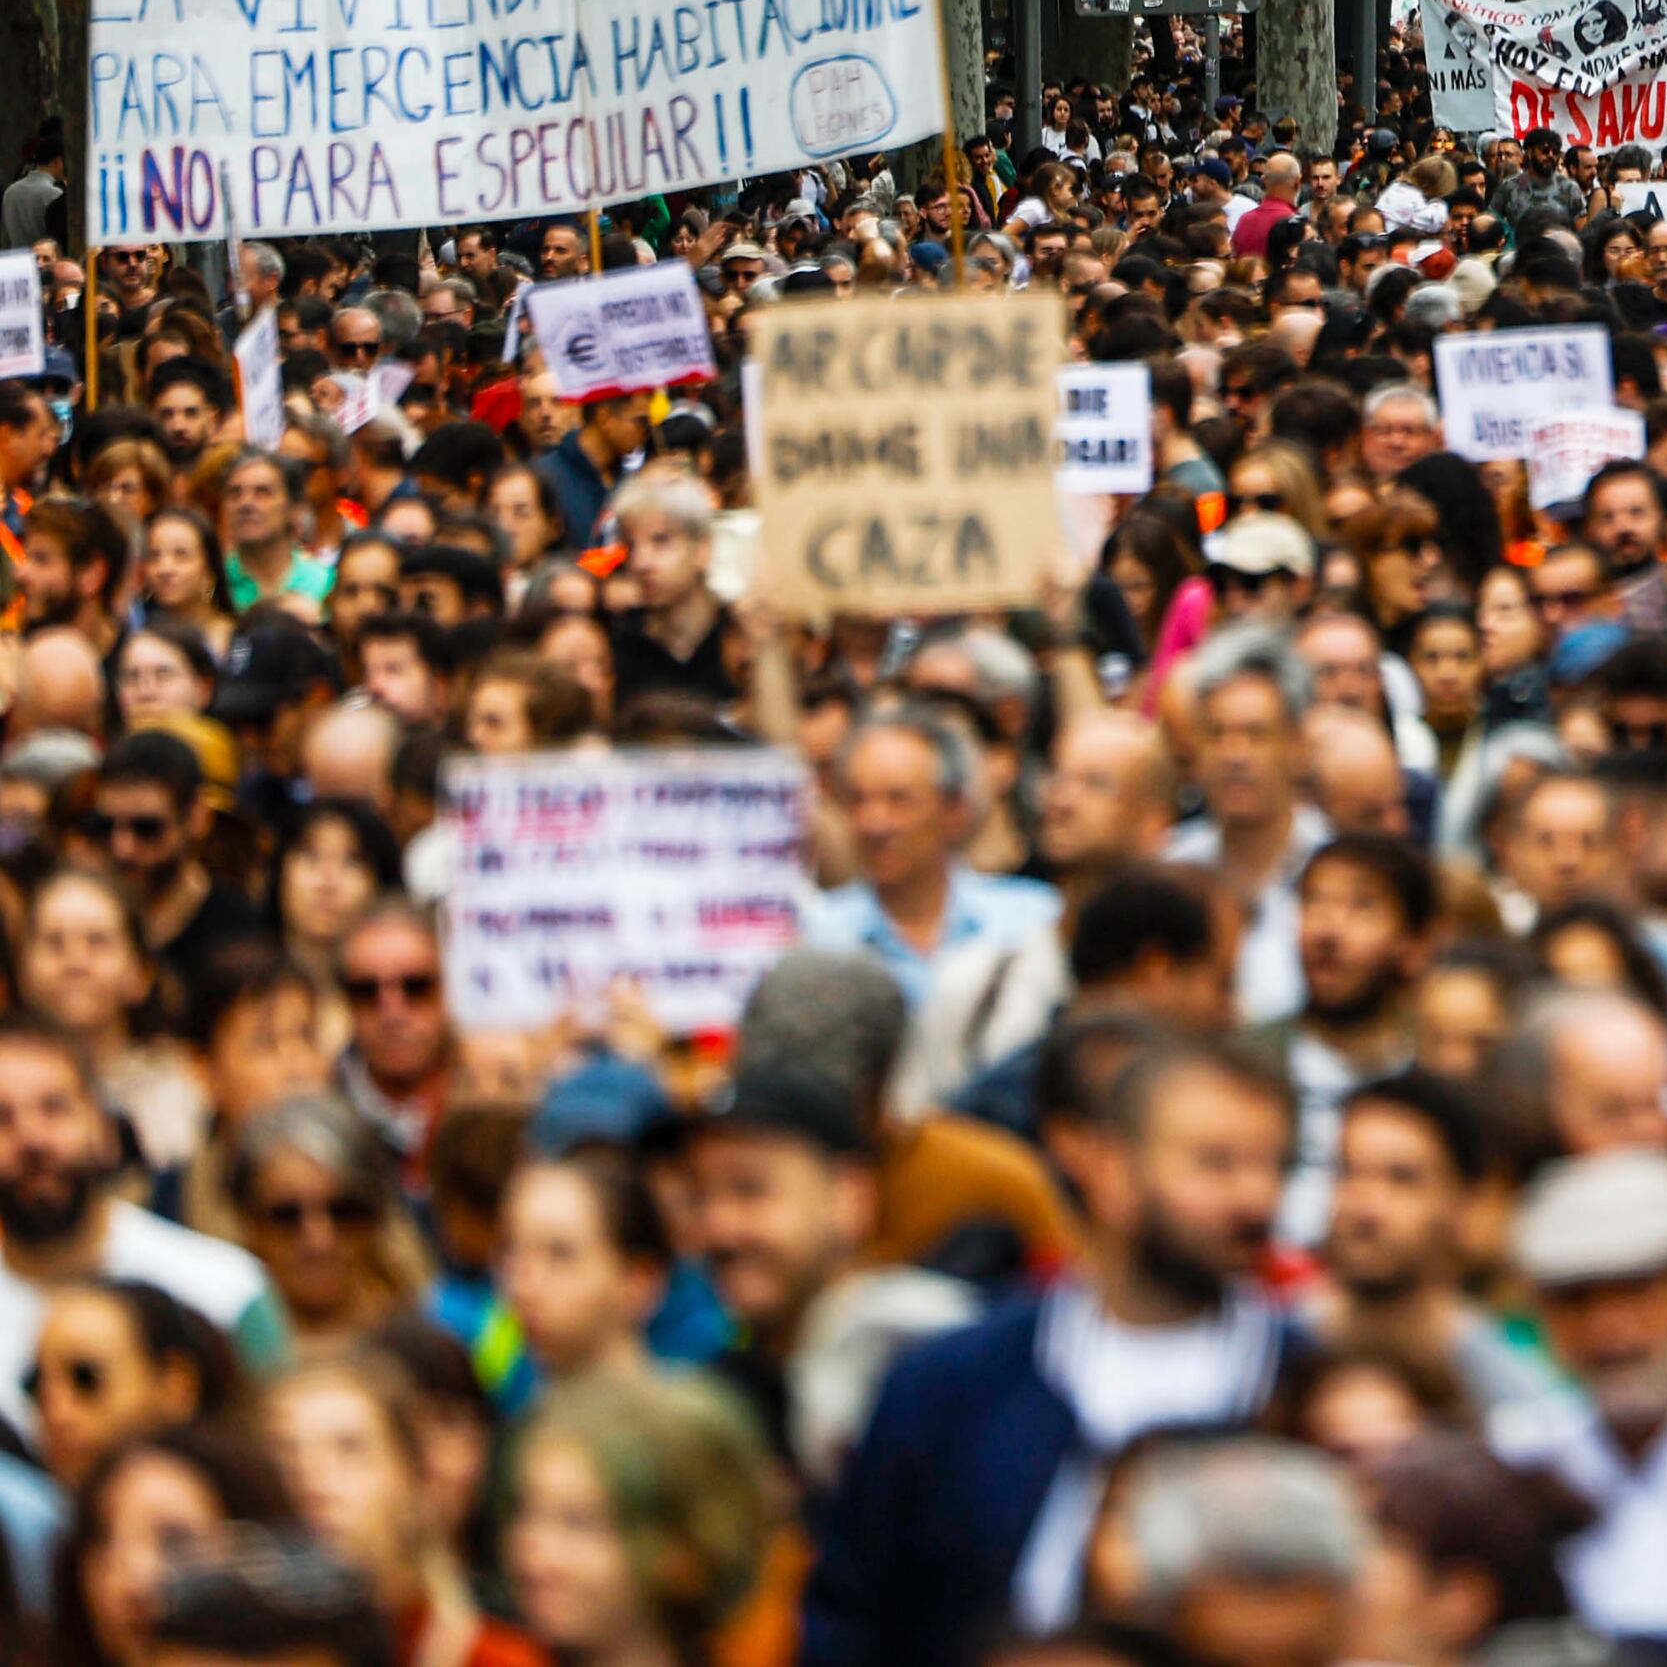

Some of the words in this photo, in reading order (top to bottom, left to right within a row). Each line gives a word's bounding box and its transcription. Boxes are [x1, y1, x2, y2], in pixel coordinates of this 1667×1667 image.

[90, 48, 236, 142] PARA
[250, 30, 596, 138] EMERGENCIA
[1450, 62, 1487, 92] MÁS
[250, 138, 398, 228] PARA
[806, 511, 1002, 590] CAZA
